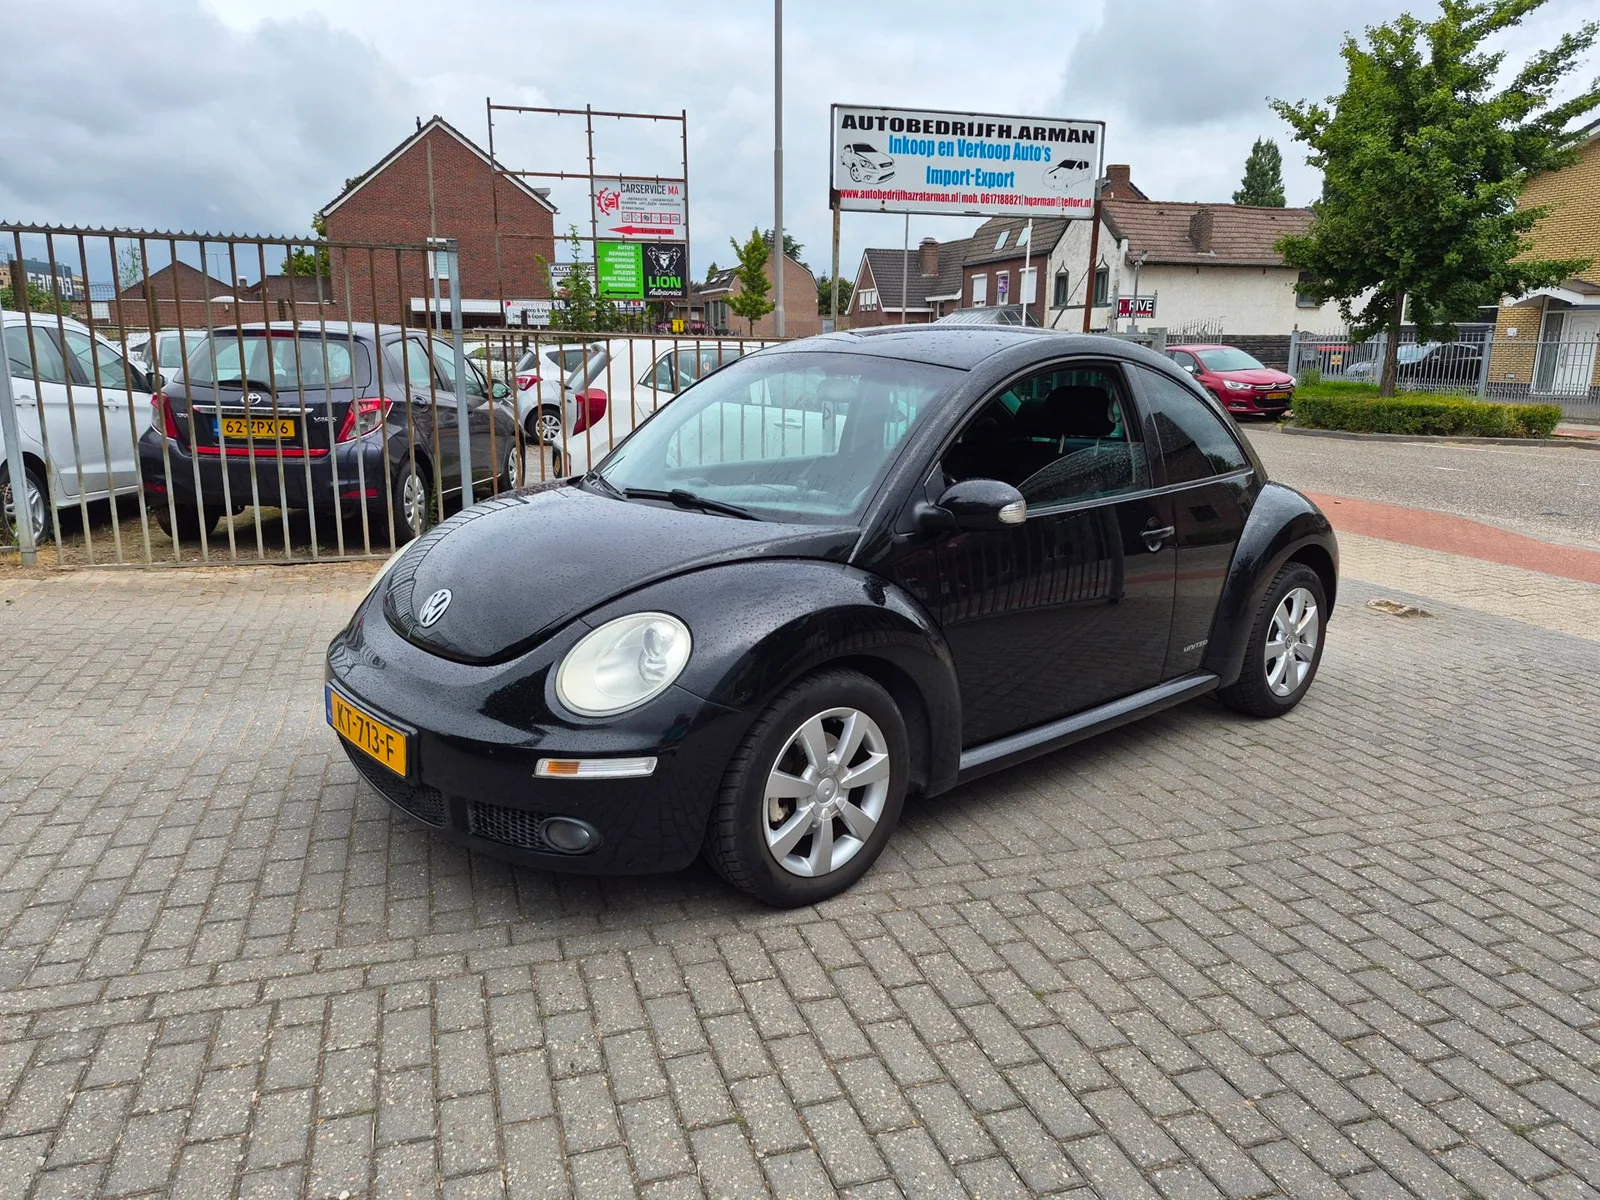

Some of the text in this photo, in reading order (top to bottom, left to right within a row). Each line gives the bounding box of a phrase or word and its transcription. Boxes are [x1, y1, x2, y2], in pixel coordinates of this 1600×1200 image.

[888, 134, 1051, 162] Inkoop en Verkoop Auto's
[926, 165, 1015, 189] Import-Export
[620, 183, 679, 195] CARSERVICE MA
[648, 276, 682, 288] LION
[648, 288, 683, 296] Autoservice
[336, 701, 394, 762] KT-713-F
